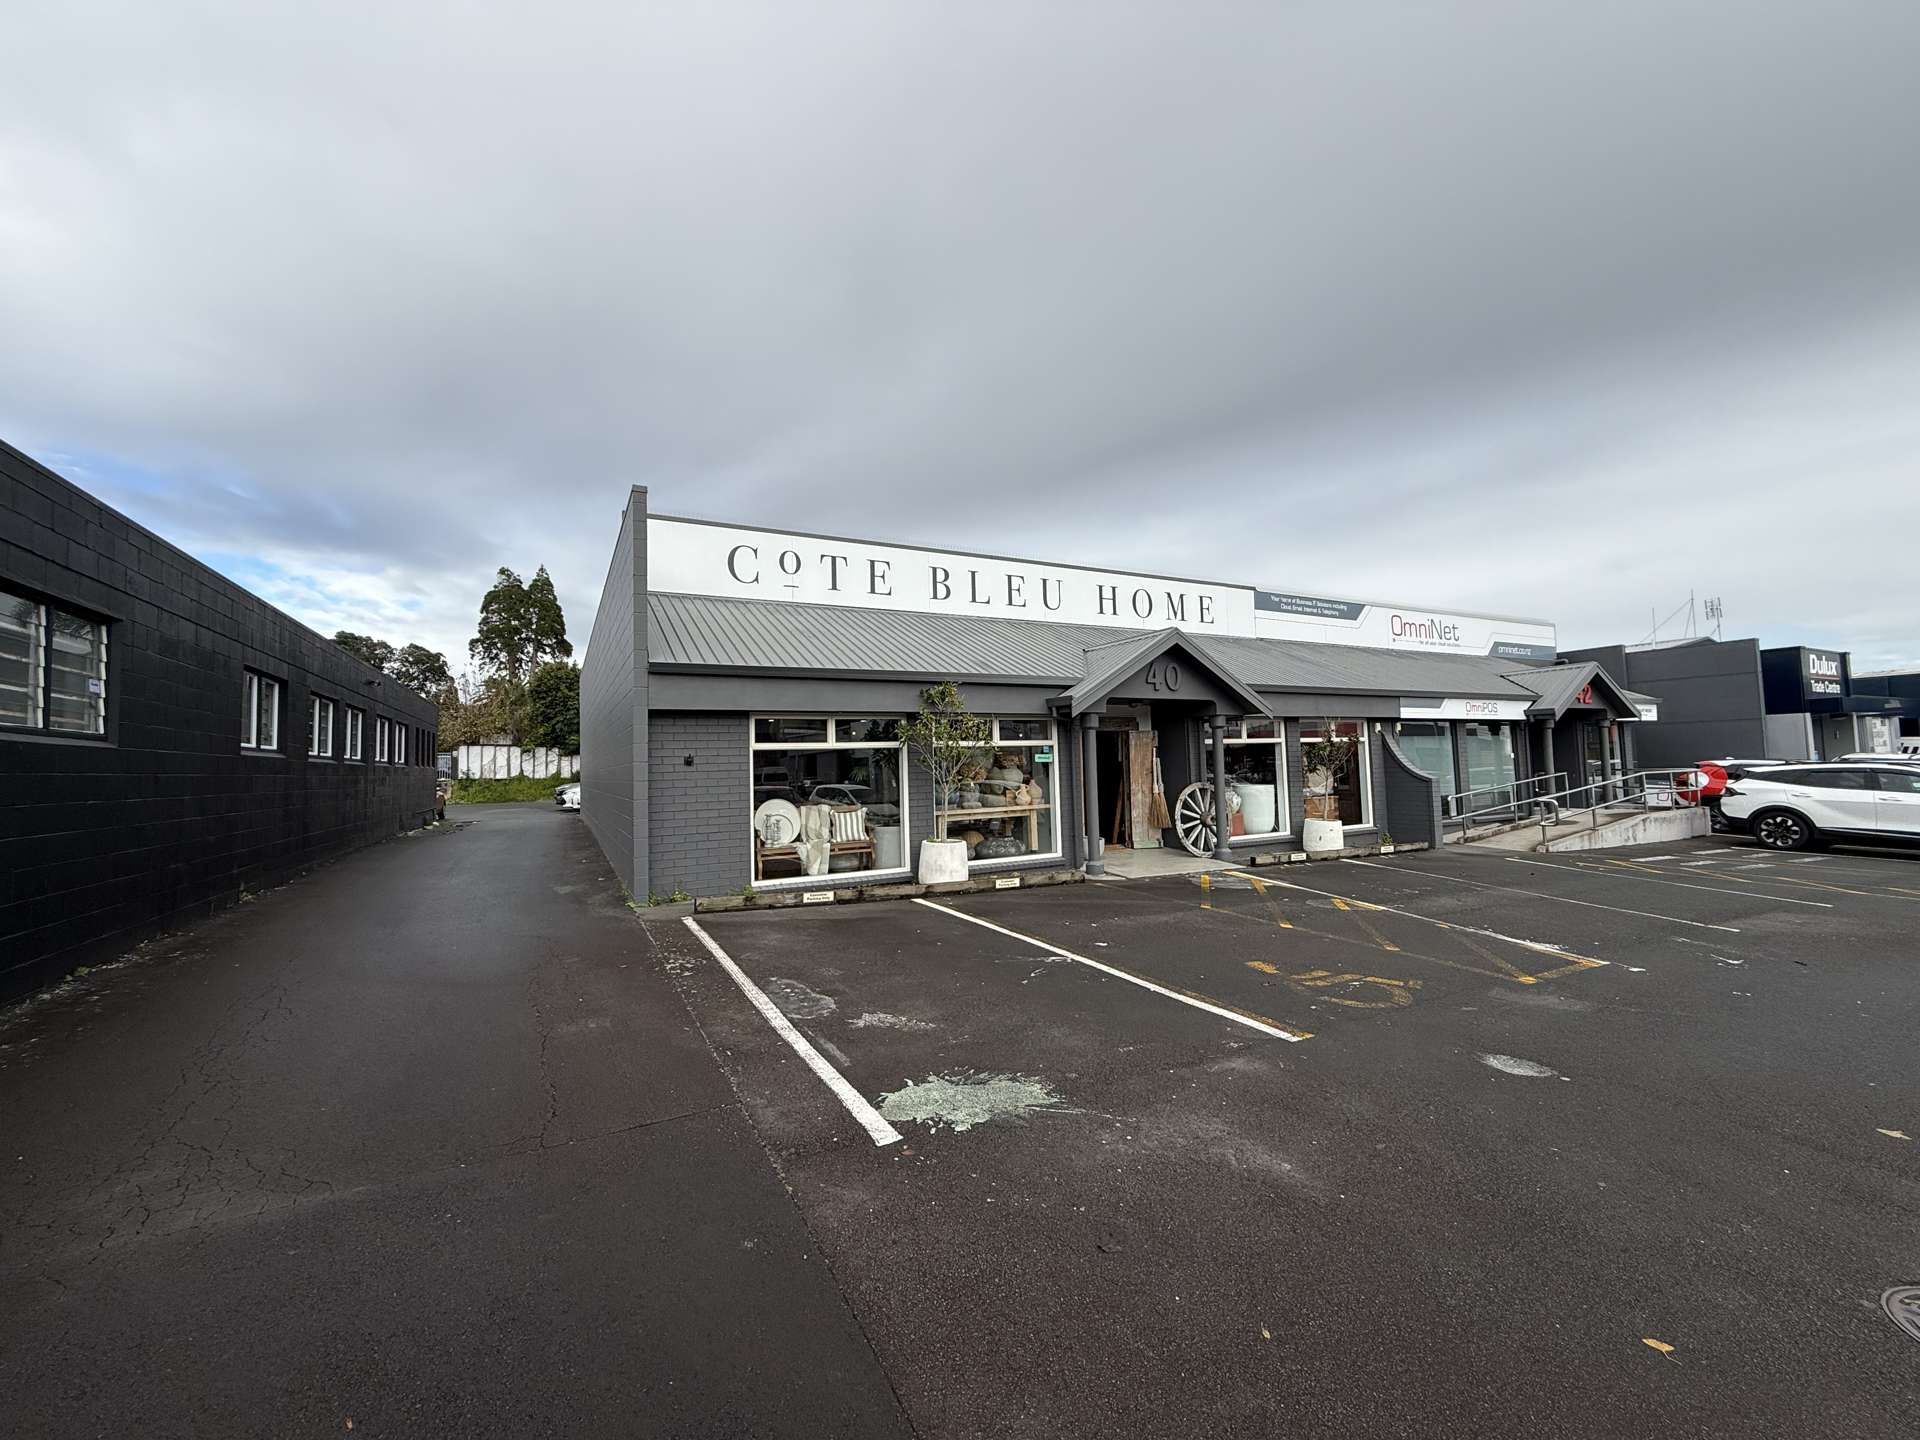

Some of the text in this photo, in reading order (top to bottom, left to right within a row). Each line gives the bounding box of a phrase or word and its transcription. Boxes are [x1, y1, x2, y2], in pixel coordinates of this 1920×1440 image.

[928, 566, 1063, 610] BLEU
[1096, 584, 1215, 624] HOME
[1391, 614, 1460, 641] OmniNet
[1809, 653, 1838, 675] Dulux
[1145, 661, 1181, 691] 40
[1810, 679, 1841, 694] Trade Centre
[1574, 684, 1593, 704] 42
[1465, 701, 1498, 713] OmniPOS
